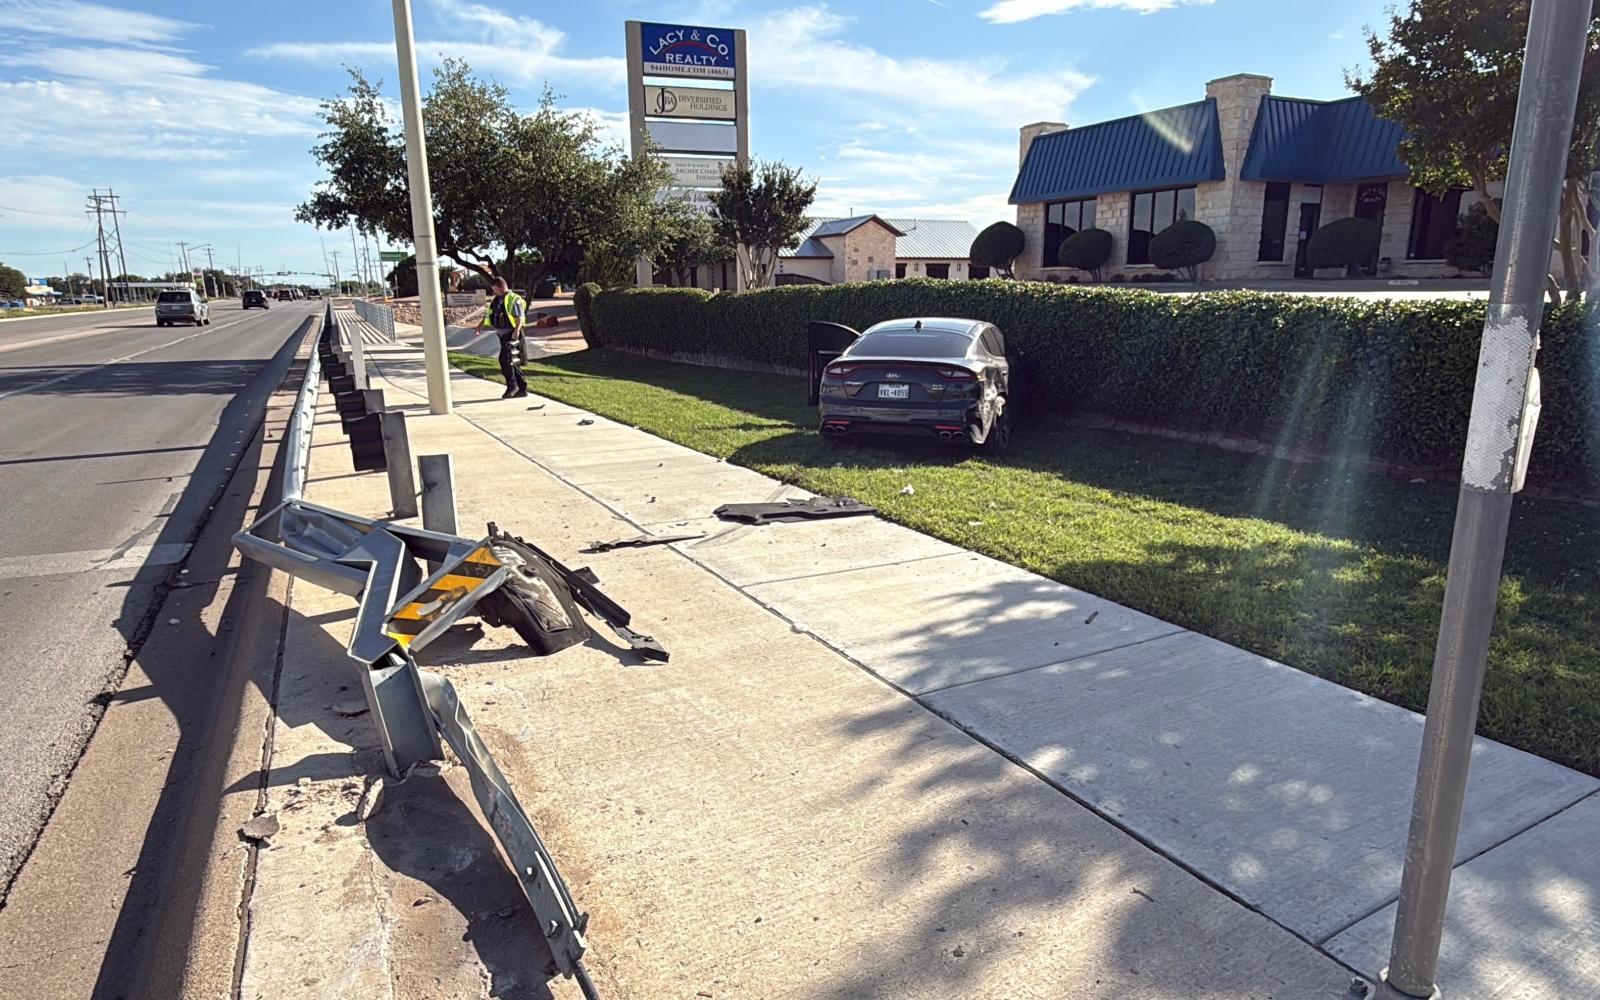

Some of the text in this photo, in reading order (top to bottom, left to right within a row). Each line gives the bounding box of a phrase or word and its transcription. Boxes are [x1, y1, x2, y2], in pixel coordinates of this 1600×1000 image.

[649, 29, 684, 55] LACY
[690, 29, 700, 41] &
[666, 53, 717, 65] REALTY
[678, 95, 722, 105] DIVERSIFIED
[690, 102, 728, 112] HOLDINGS
